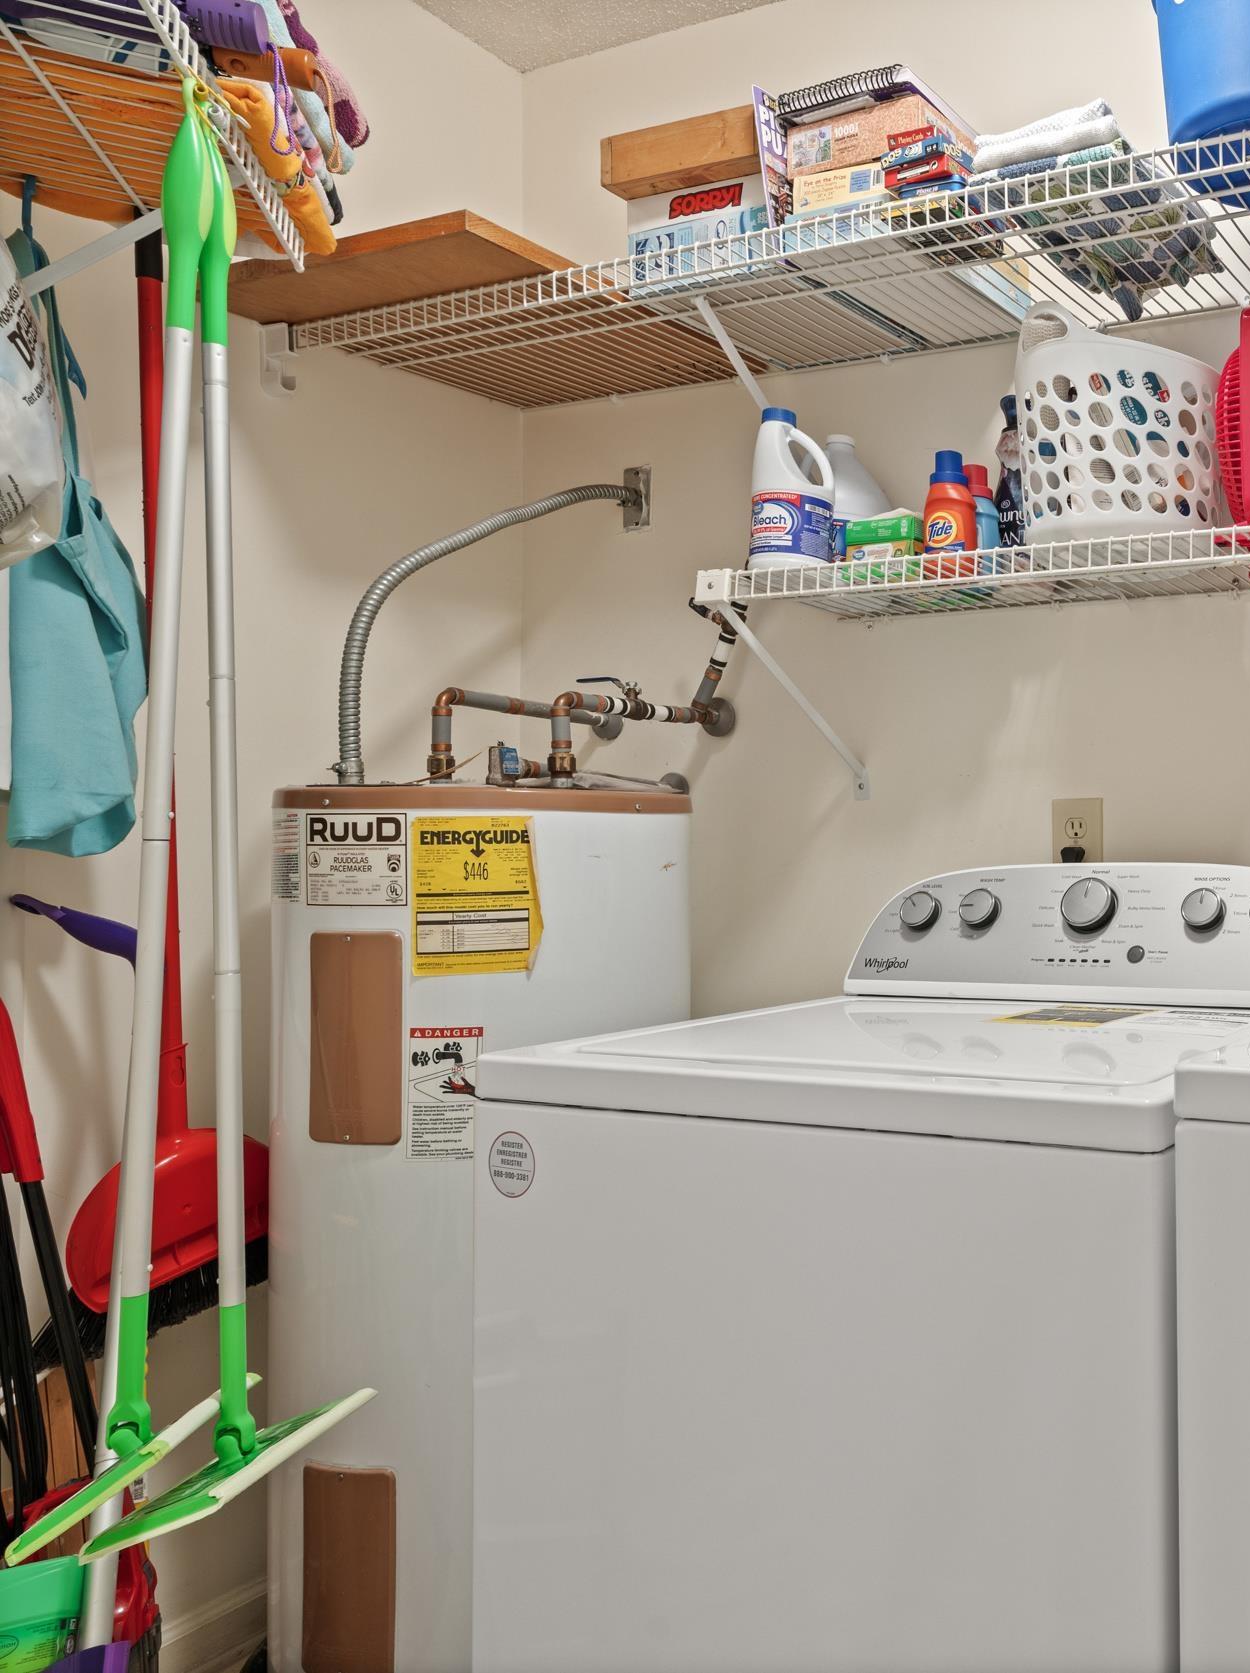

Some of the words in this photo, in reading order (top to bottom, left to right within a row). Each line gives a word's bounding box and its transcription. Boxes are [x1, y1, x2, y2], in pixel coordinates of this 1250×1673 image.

[881, 147, 903, 169] DOS
[943, 142, 962, 158] DOS
[669, 183, 744, 219] SORRY!
[753, 514, 787, 527] Bleach
[1000, 510, 1026, 526] wny
[928, 519, 954, 542] Tide
[309, 816, 403, 843] RUUD
[333, 856, 369, 865] RUUDGLAS
[330, 865, 373, 873] PACEMAKER
[463, 860, 490, 881] $446
[863, 956, 909, 974] Whirlpool
[424, 1028, 480, 1038] DANGER
[501, 1140, 524, 1149] REGISTER
[496, 1149, 528, 1159] ENREGISTRER
[500, 1158, 523, 1167] REGISTRE
